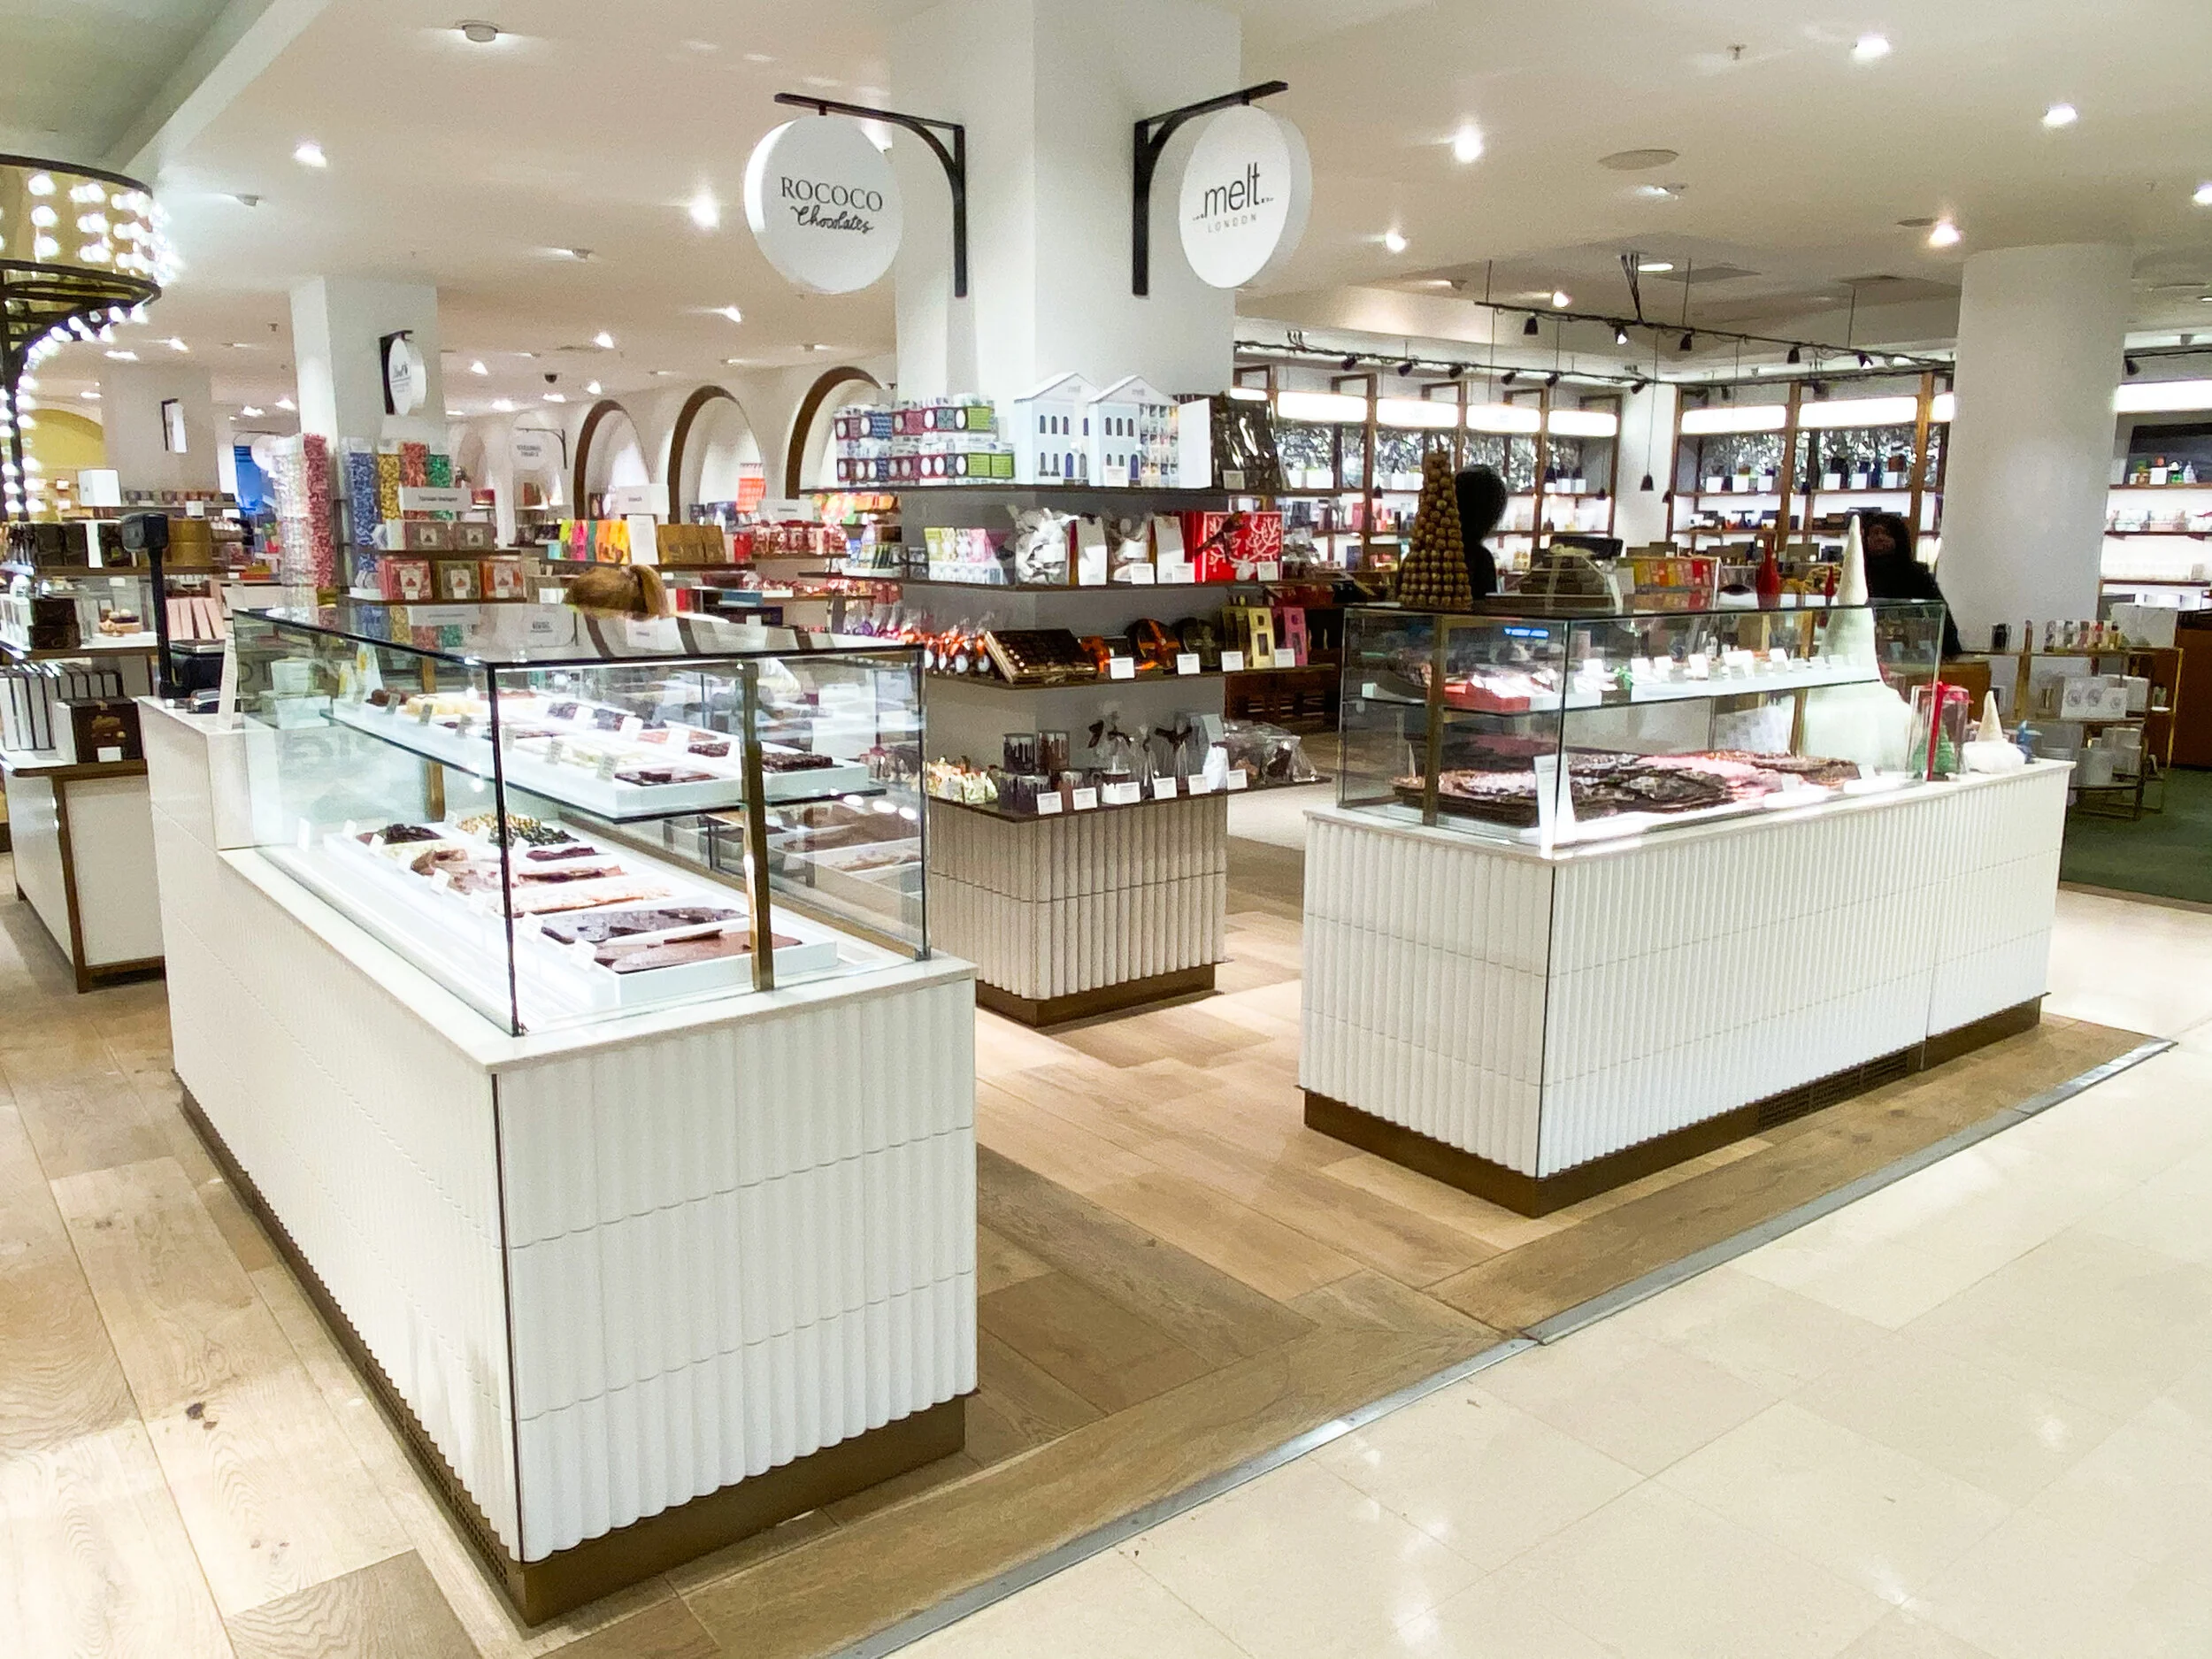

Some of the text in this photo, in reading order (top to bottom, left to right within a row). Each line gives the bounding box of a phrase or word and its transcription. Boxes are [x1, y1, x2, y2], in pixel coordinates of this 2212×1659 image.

[781, 176, 883, 211] ROCOCO
[790, 204, 874, 234] Chocolates
[1208, 213, 1257, 233] LONDON
